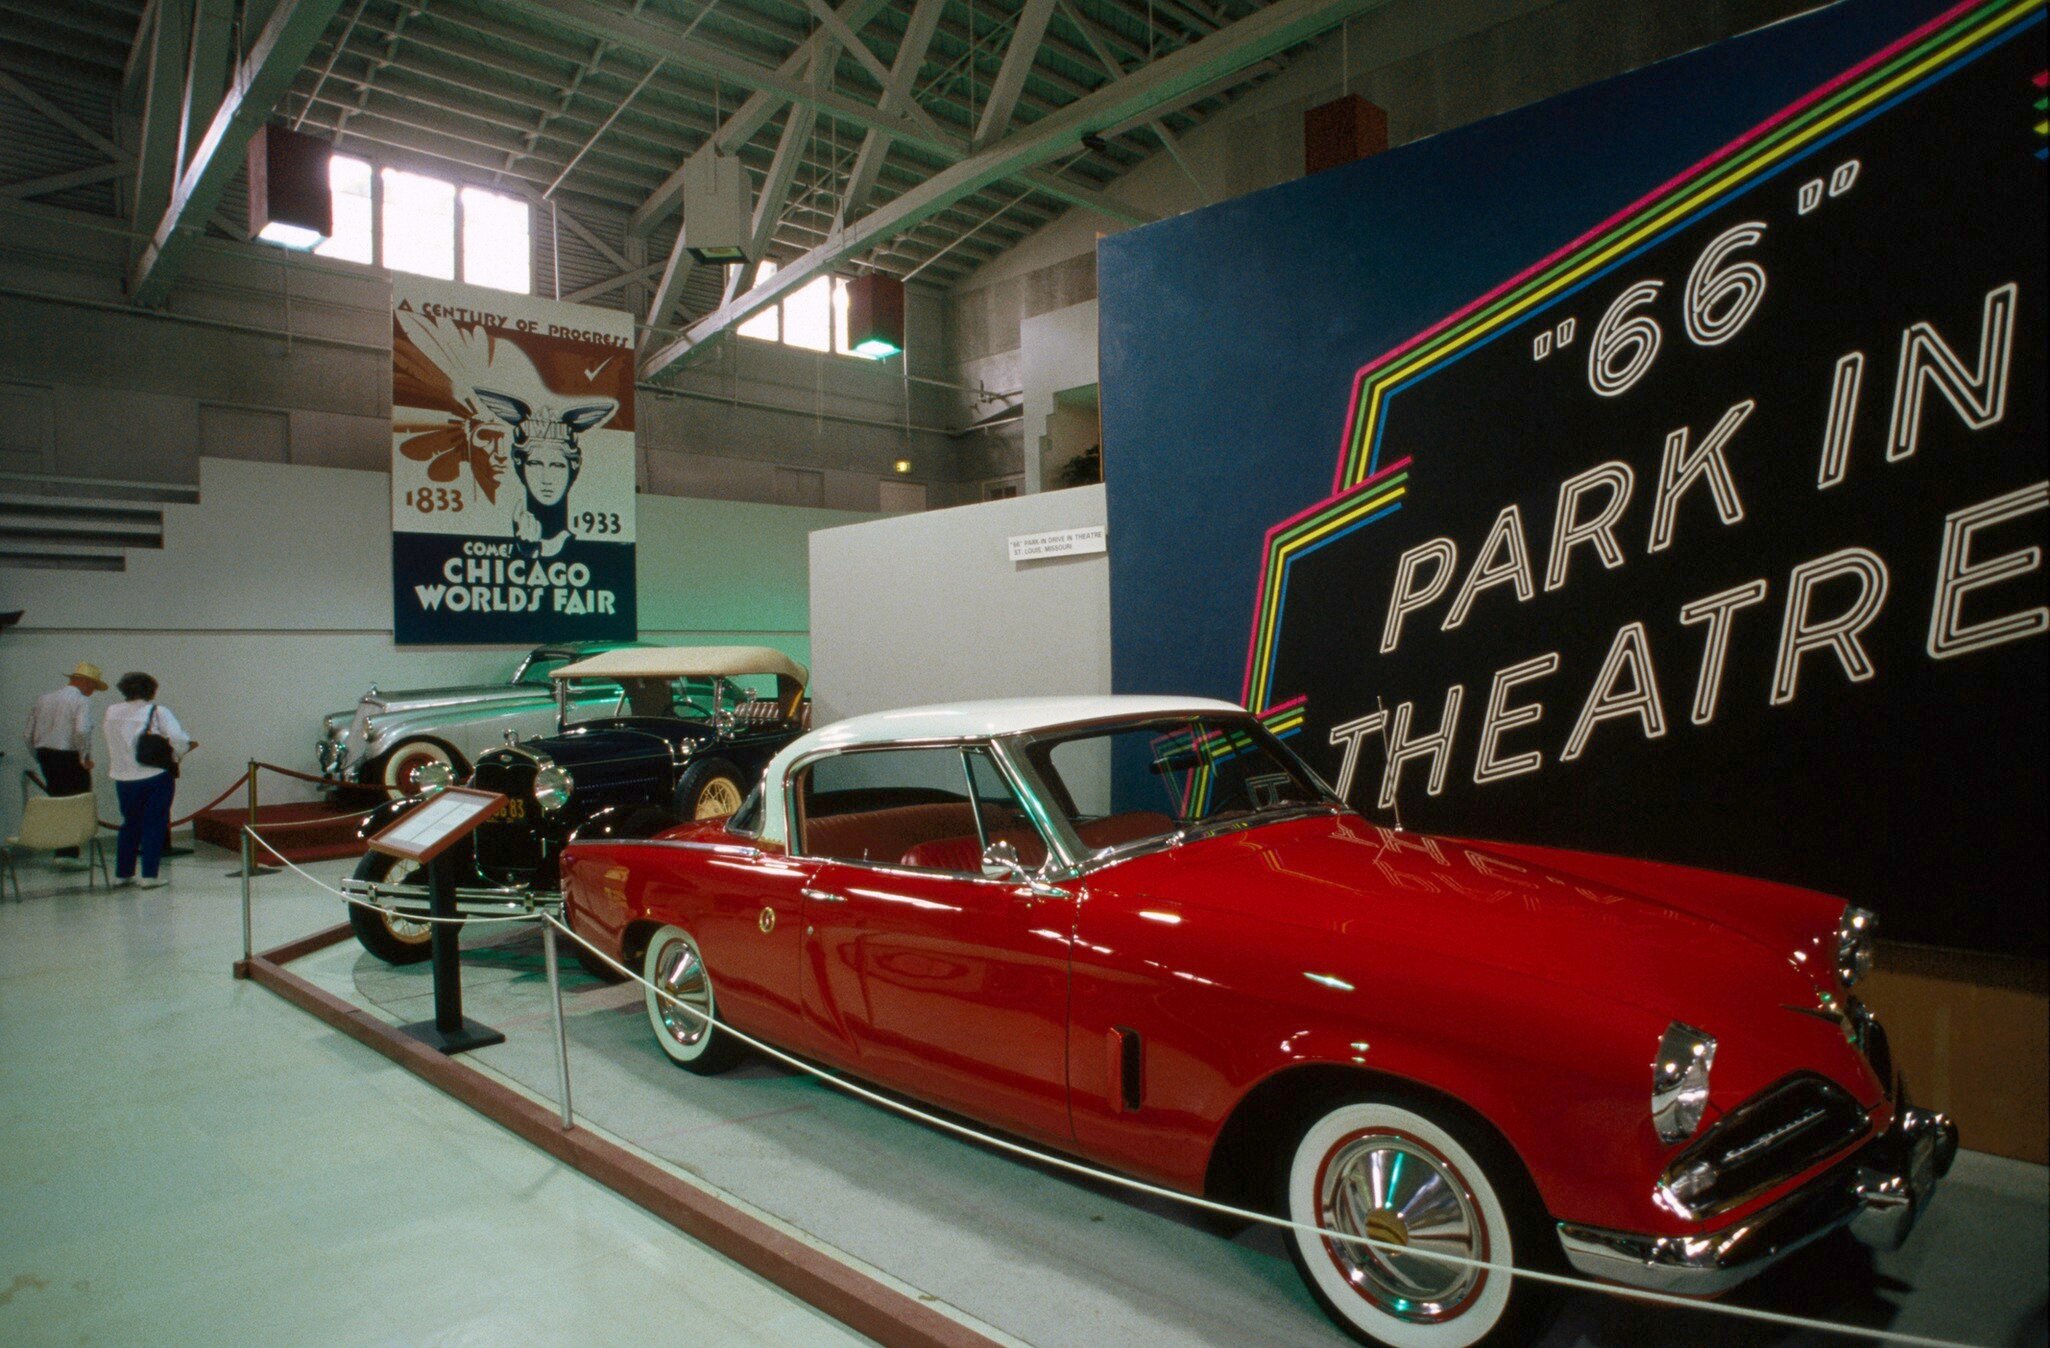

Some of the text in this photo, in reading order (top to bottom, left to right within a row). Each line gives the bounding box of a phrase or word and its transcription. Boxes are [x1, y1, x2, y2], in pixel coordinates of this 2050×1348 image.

[397, 298, 629, 348] A CENTURY OF PROGRESS
[1379, 282, 2018, 655] PARK IN
[406, 487, 464, 514] 1833
[573, 511, 622, 535] 1933
[463, 541, 513, 559] COME!
[1044, 543, 1072, 553] MISSOURI
[1048, 535, 1065, 543] DRIVE
[1074, 531, 1102, 540] THEATRE
[443, 558, 591, 587] CHICAGO
[553, 589, 616, 615] FAIR
[1329, 480, 2049, 809] THEATRE
